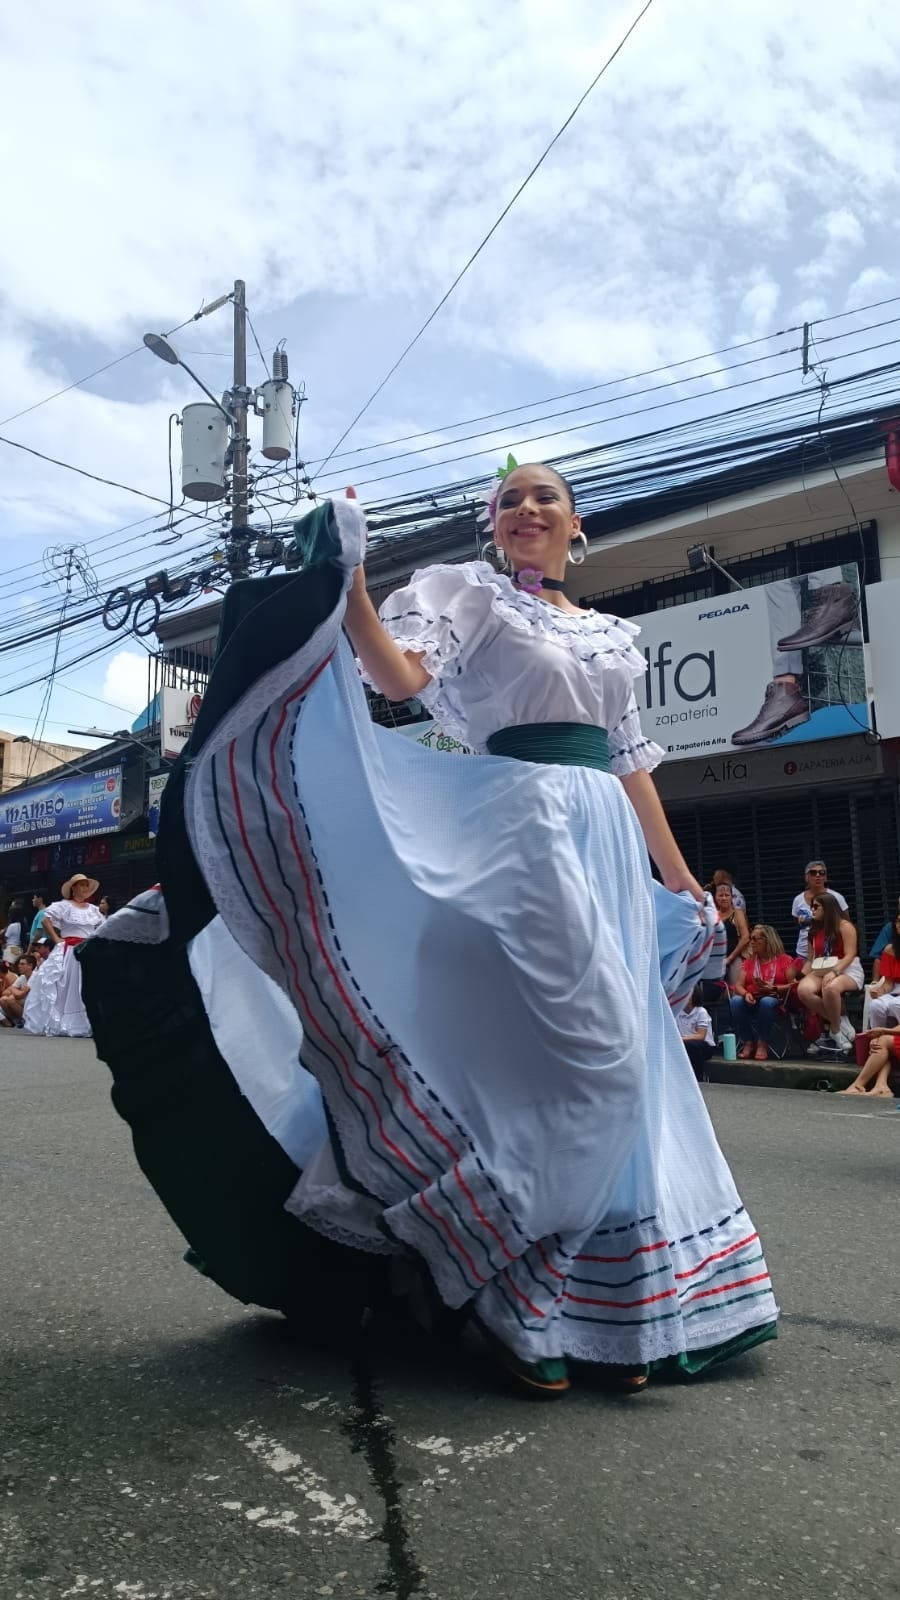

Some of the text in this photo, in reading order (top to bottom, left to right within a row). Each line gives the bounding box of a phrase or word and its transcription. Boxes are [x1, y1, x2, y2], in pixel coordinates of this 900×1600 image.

[698, 603, 750, 621] PEGADA
[644, 641, 717, 709] lfa
[711, 738, 727, 746] Alfa
[847, 753, 872, 767] ALFA
[699, 759, 748, 785] Alfa
